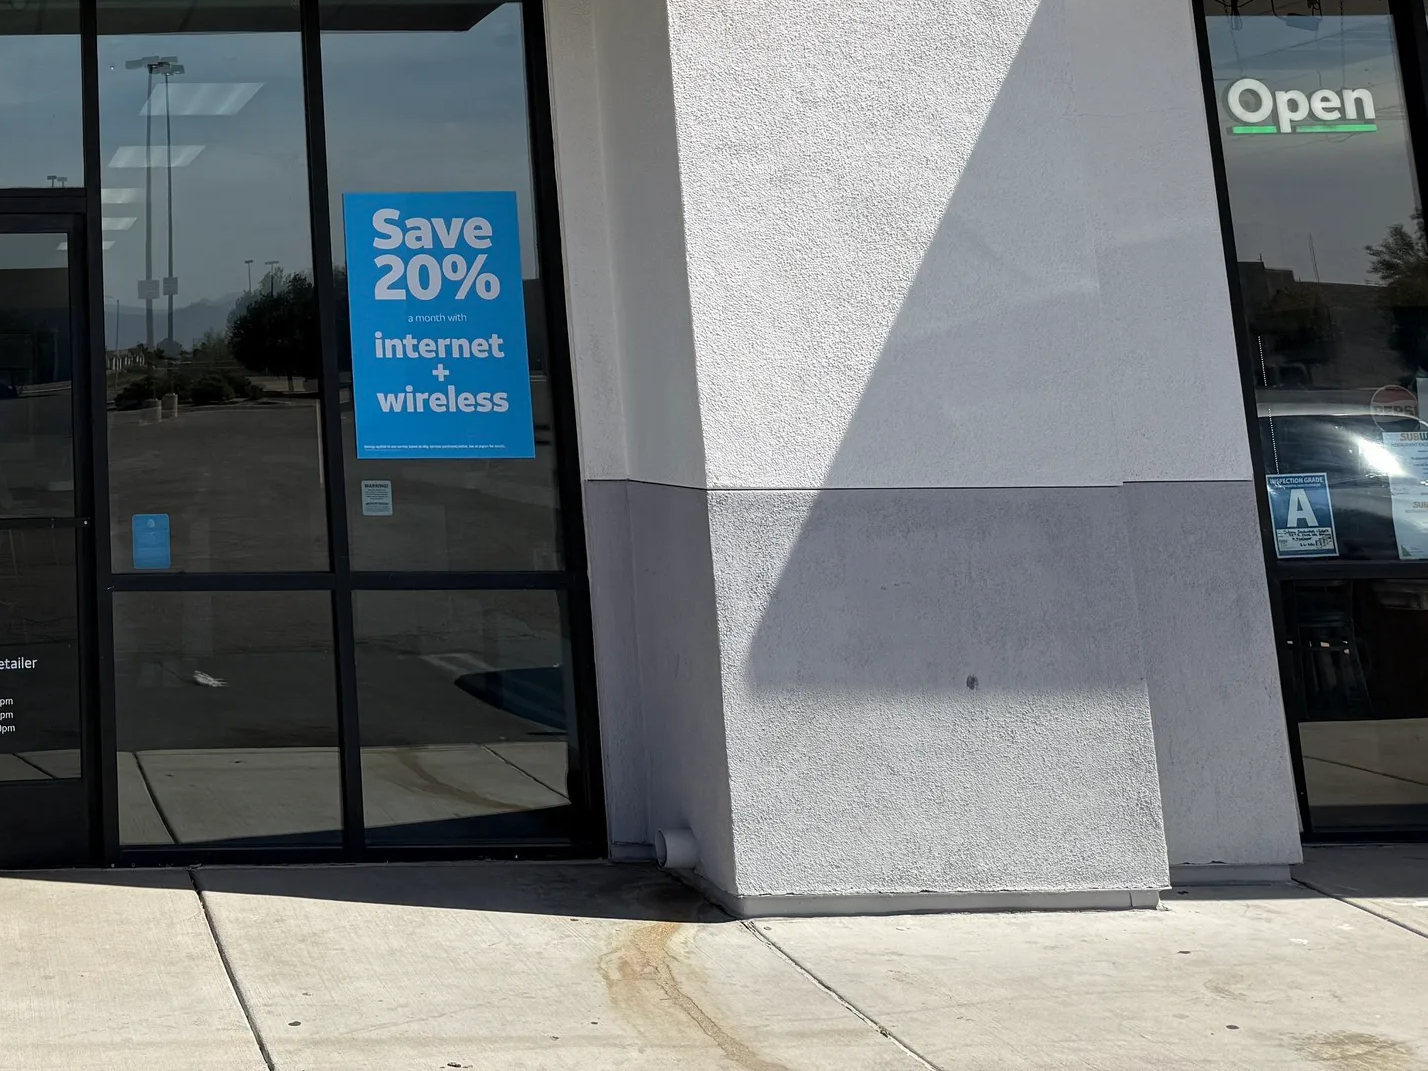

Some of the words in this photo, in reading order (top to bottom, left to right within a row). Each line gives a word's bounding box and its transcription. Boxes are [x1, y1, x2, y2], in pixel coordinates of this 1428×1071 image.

[1227, 78, 1376, 133] Open
[372, 208, 493, 250] Save
[374, 253, 501, 301] 20%
[415, 313, 446, 322] month
[447, 313, 467, 322] with
[374, 331, 505, 359] internet
[432, 363, 450, 381] +
[376, 385, 509, 412] wireless
[1270, 477, 1303, 485] INSPECTION
[1286, 489, 1320, 527] A
